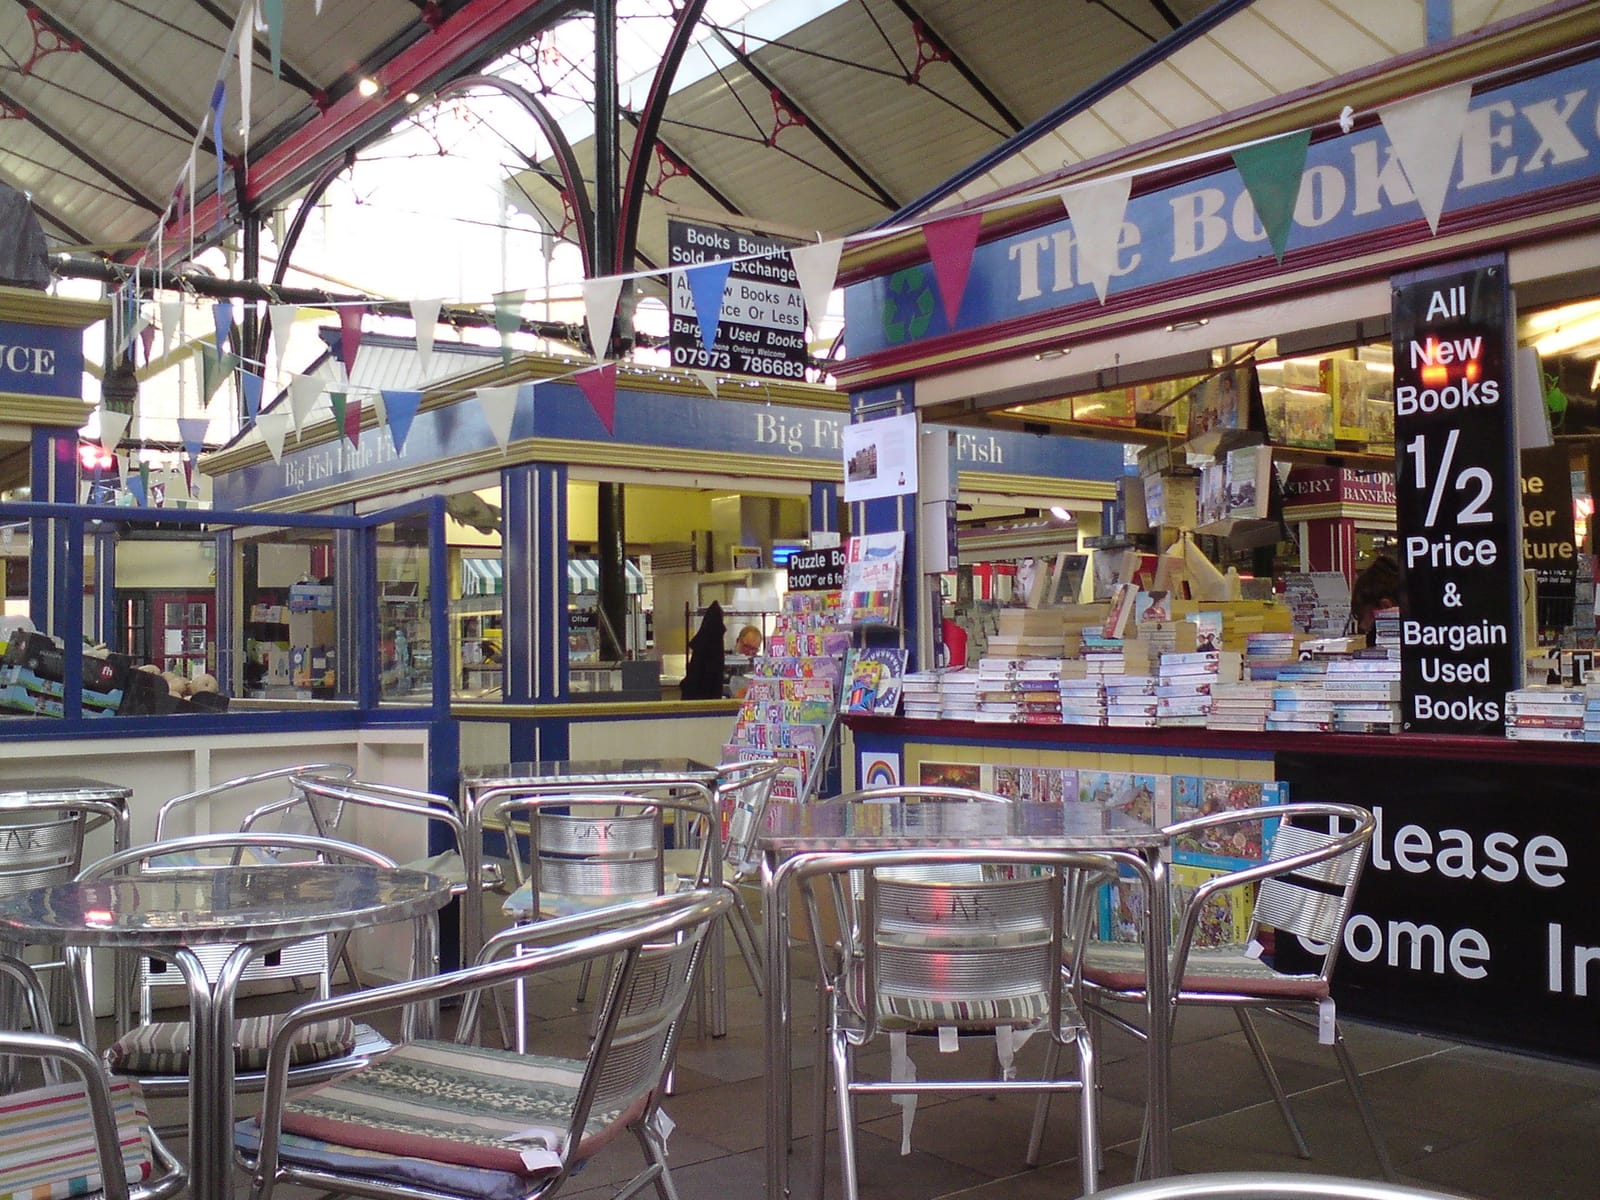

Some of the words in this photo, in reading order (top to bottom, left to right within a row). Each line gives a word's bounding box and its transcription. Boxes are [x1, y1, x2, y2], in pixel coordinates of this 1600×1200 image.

[1008, 222, 1142, 301] The
[1457, 88, 1600, 189] Ex
[687, 228, 730, 250] Books
[672, 247, 705, 267] Sold
[741, 286, 780, 305] Books
[787, 294, 802, 308] At
[1426, 286, 1466, 322] All
[748, 306, 765, 321] Or
[772, 310, 800, 325] Less
[673, 318, 722, 337] Bargn
[729, 327, 760, 343] Used
[767, 332, 804, 350] Books
[732, 344, 755, 355] Orders
[674, 347, 731, 370] 07973
[740, 355, 804, 378] 786683
[1410, 336, 1482, 369] New
[1397, 378, 1500, 416] Books
[754, 412, 804, 454] Big
[956, 433, 1004, 464] Fish
[285, 460, 305, 491] Big
[307, 453, 333, 482] Fish
[337, 438, 373, 474] Little
[1406, 429, 1494, 528] 1/2
[790, 552, 826, 570] Puzzle
[831, 550, 846, 566] Bo
[1406, 535, 1498, 569] Price
[818, 576, 826, 585] or
[827, 573, 833, 585] 6
[834, 572, 843, 584] fo
[1442, 582, 1463, 608] &
[1403, 619, 1507, 651] Bargain
[1420, 658, 1490, 683] Used
[1414, 695, 1500, 721] Books
